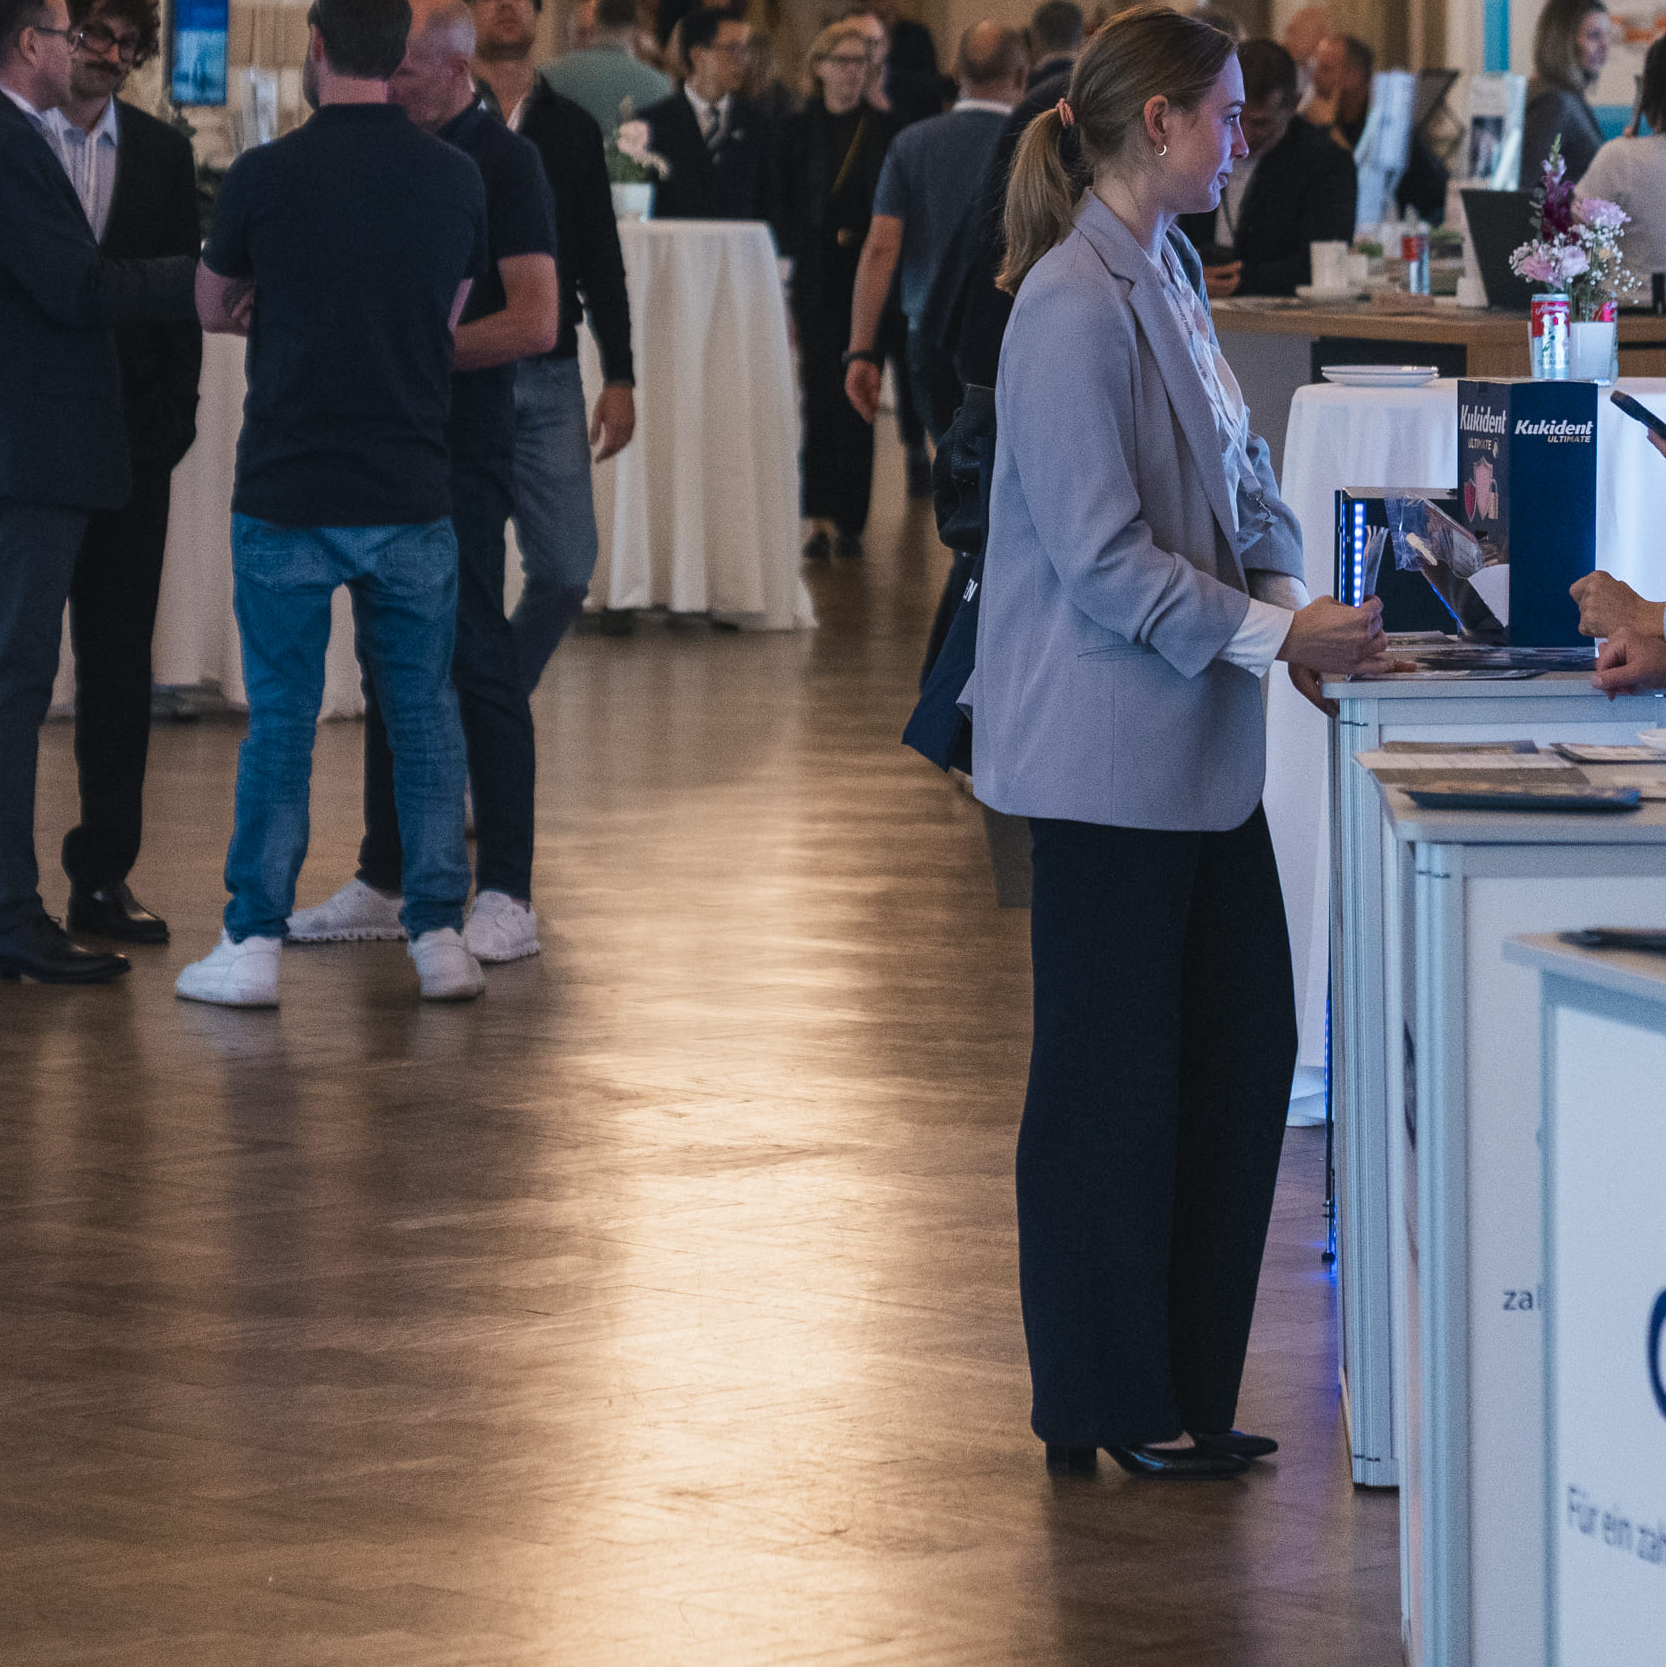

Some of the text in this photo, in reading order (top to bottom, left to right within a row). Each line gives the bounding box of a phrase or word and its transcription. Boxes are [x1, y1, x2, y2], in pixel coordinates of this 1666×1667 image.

[1459, 404, 1507, 434] Kukident
[1514, 419, 1594, 435] Kukident
[1468, 437, 1492, 451] ULTIMATE
[1547, 435, 1591, 443] ULTIMATE
[1567, 1484, 1598, 1536] Für
[1602, 1505, 1633, 1551] ein
